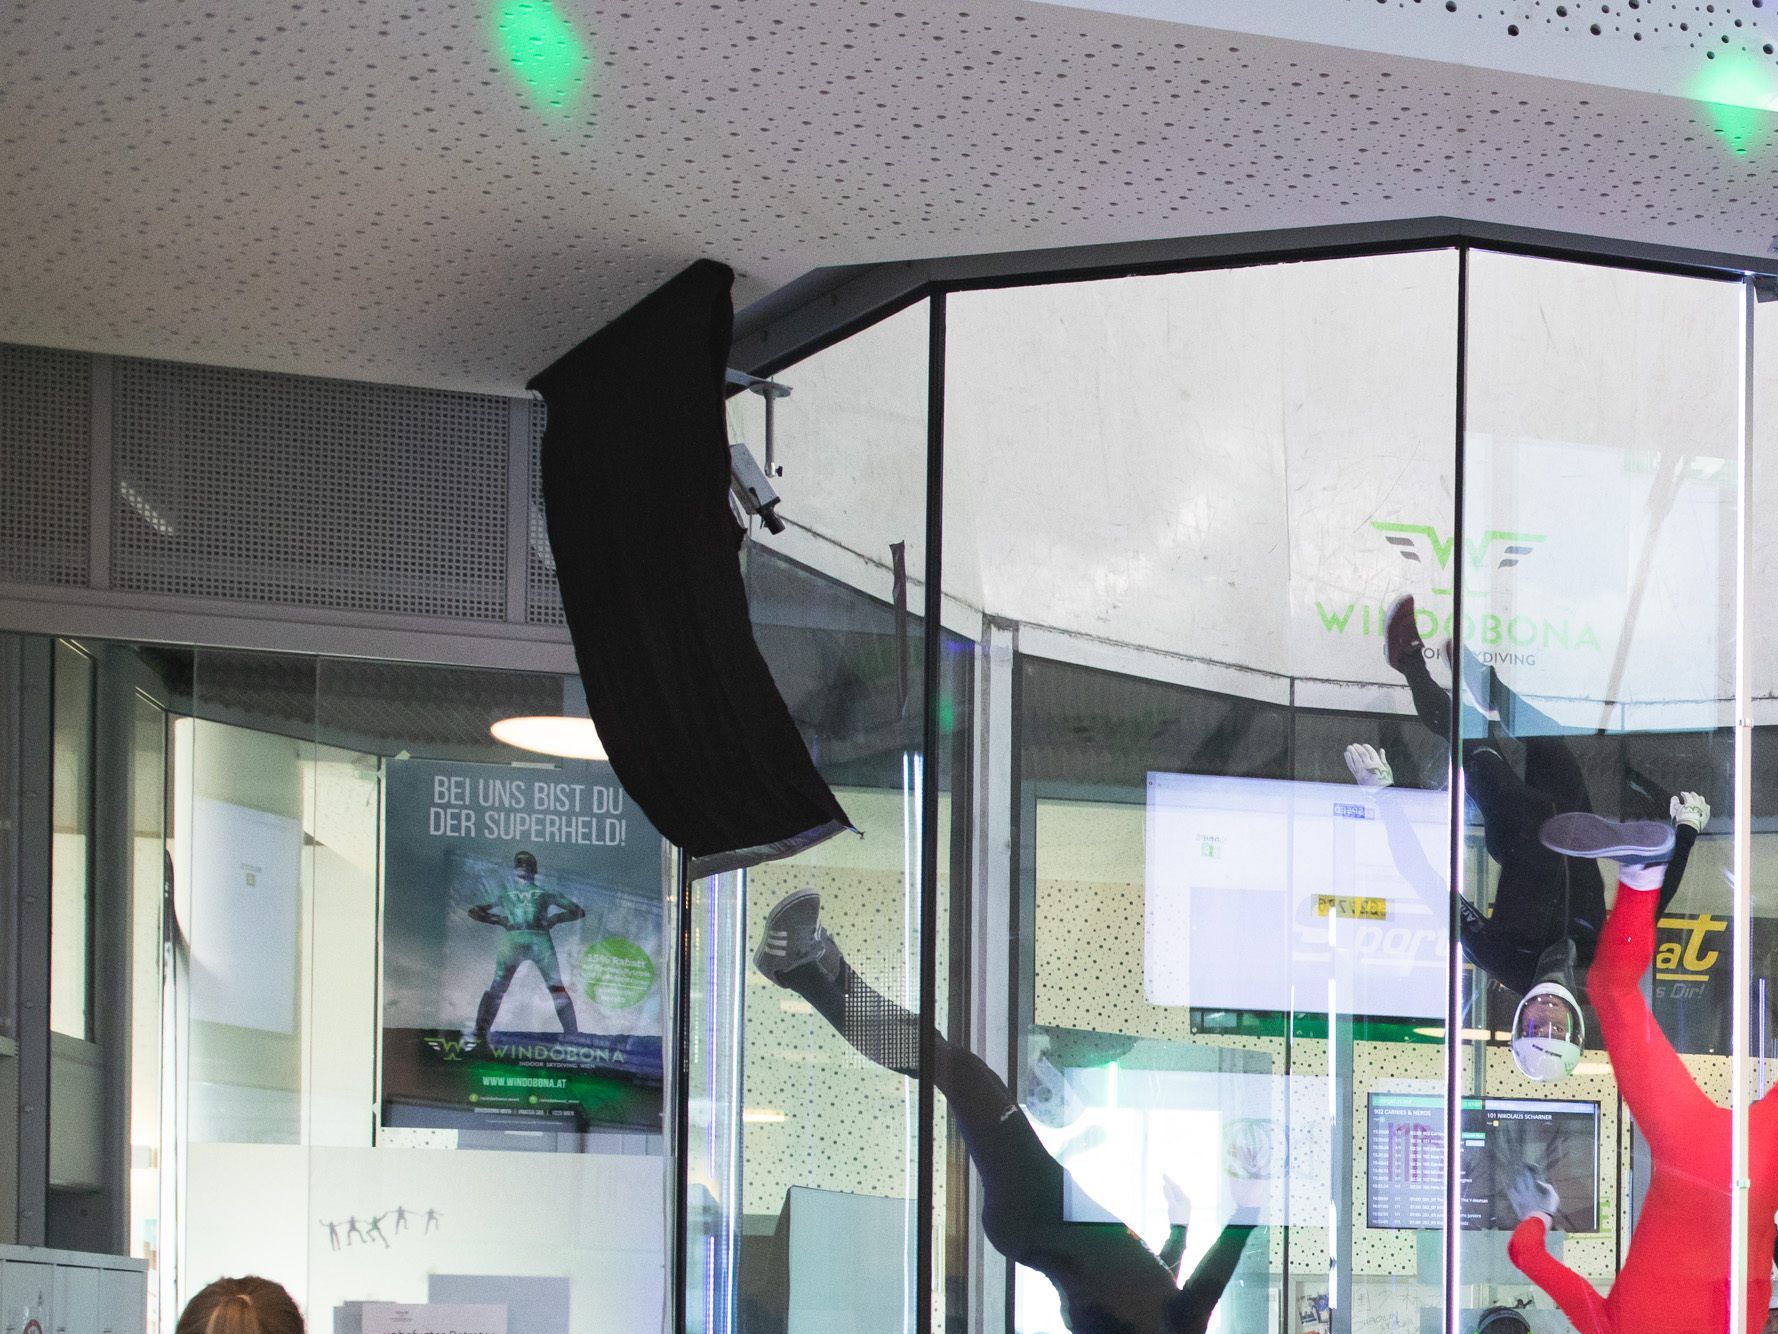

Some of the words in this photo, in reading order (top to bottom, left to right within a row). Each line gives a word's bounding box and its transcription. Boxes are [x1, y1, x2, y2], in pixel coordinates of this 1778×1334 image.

[1316, 601, 1601, 652] WIDOBONA
[434, 776, 470, 805] BEI
[479, 779, 525, 808] UNS
[534, 782, 585, 812] BIST
[593, 786, 624, 815] DU
[430, 808, 475, 837] DER
[484, 811, 627, 846] SUPERHELD!
[1656, 914, 1728, 972] at
[490, 1043, 625, 1064] WINDOBONA
[482, 1076, 568, 1090] WWW.WINDOBONA.AT
